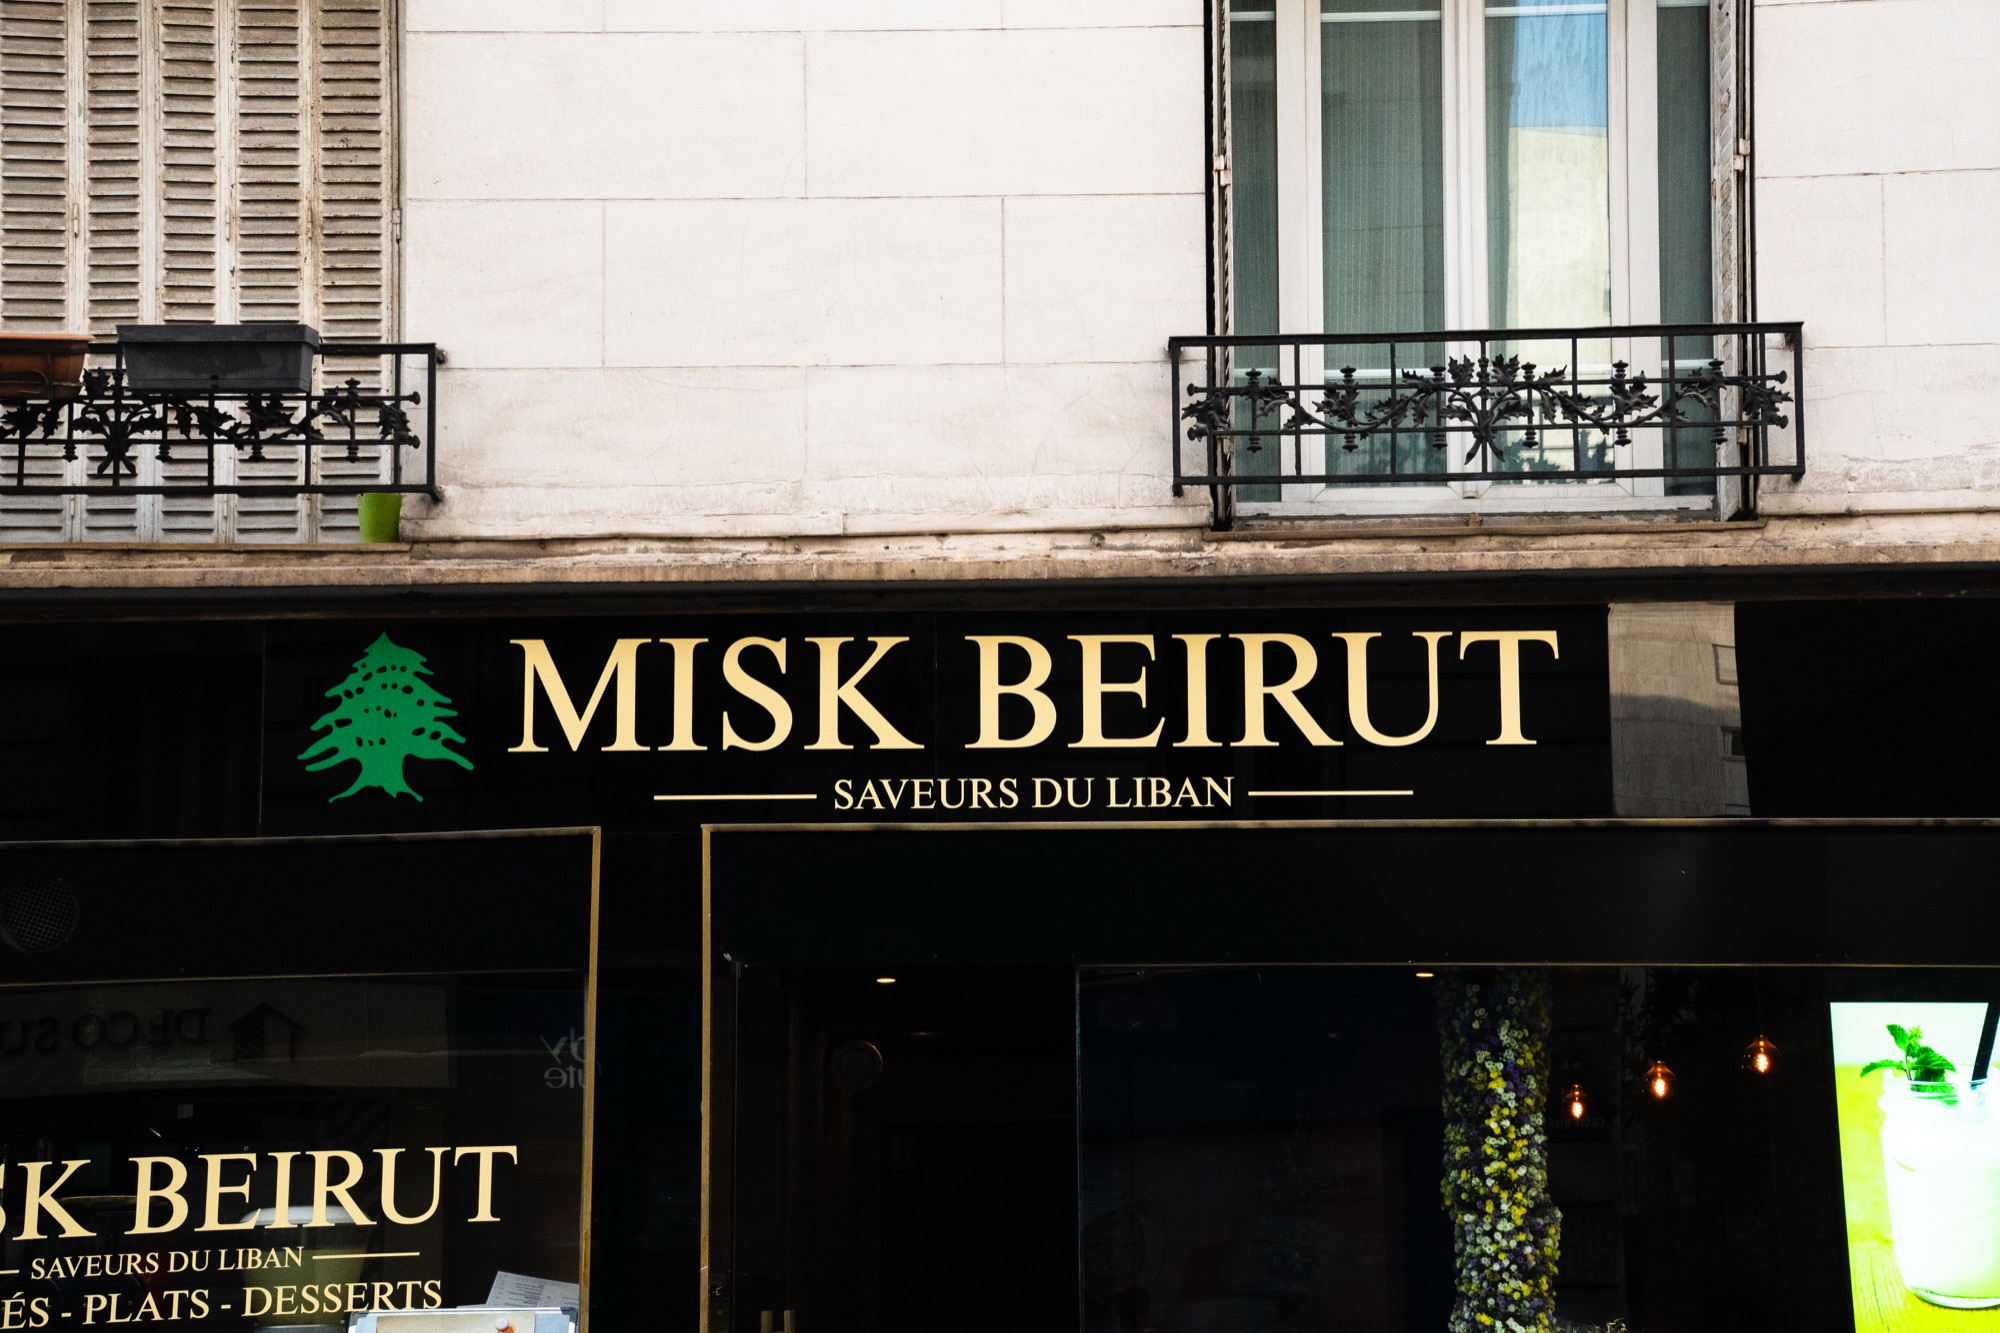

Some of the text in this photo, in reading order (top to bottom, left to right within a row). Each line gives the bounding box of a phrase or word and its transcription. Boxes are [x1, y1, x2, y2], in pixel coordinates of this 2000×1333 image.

[508, 631, 1559, 752] MISK BEIRUT
[835, 777, 1232, 809] SAVEURS DU LIBAN
[0, 1146, 517, 1240] K BEIRUT
[32, 1247, 303, 1279] SAVEURS DU LIBAN
[83, 1290, 209, 1324] PLATS
[241, 1280, 442, 1317] DESSERTS
